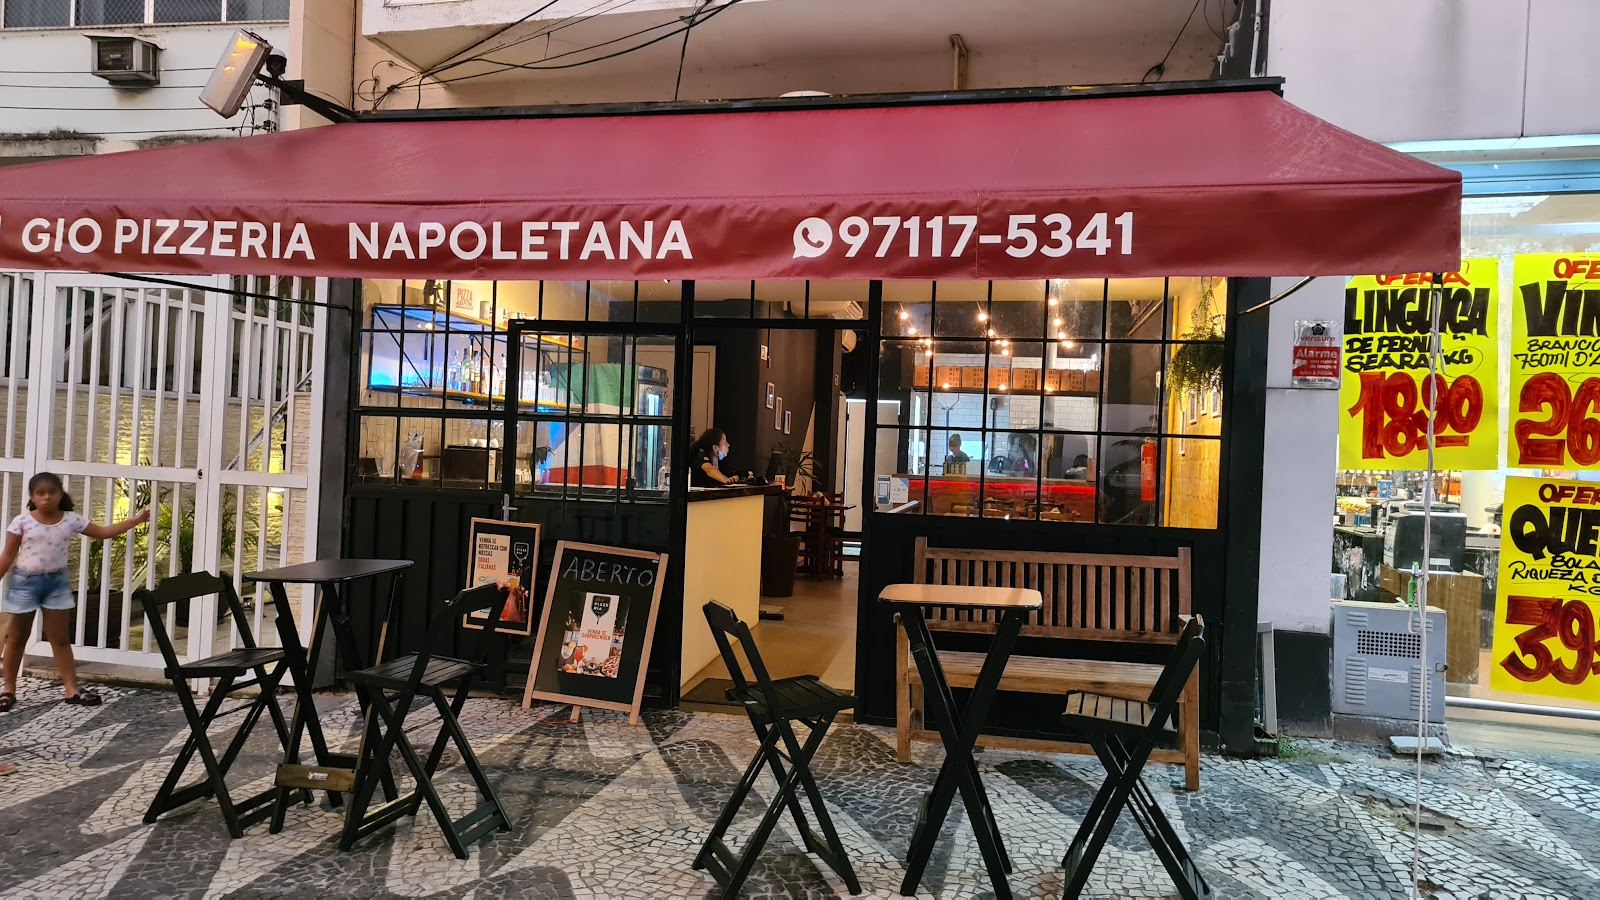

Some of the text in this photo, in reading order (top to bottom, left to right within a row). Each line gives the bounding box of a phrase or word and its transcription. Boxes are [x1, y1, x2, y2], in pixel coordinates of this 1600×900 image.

[22, 217, 693, 261] GIO PIZZERIA NAPOLETANA
[838, 212, 1133, 258] 97117-5341
[457, 288, 472, 302] PIZZA
[1296, 349, 1338, 358] Alarme
[1346, 337, 1374, 354] DE
[1444, 349, 1473, 365] KG
[562, 556, 654, 588] ABERTO
[1508, 561, 1588, 584] RIQUEZA
